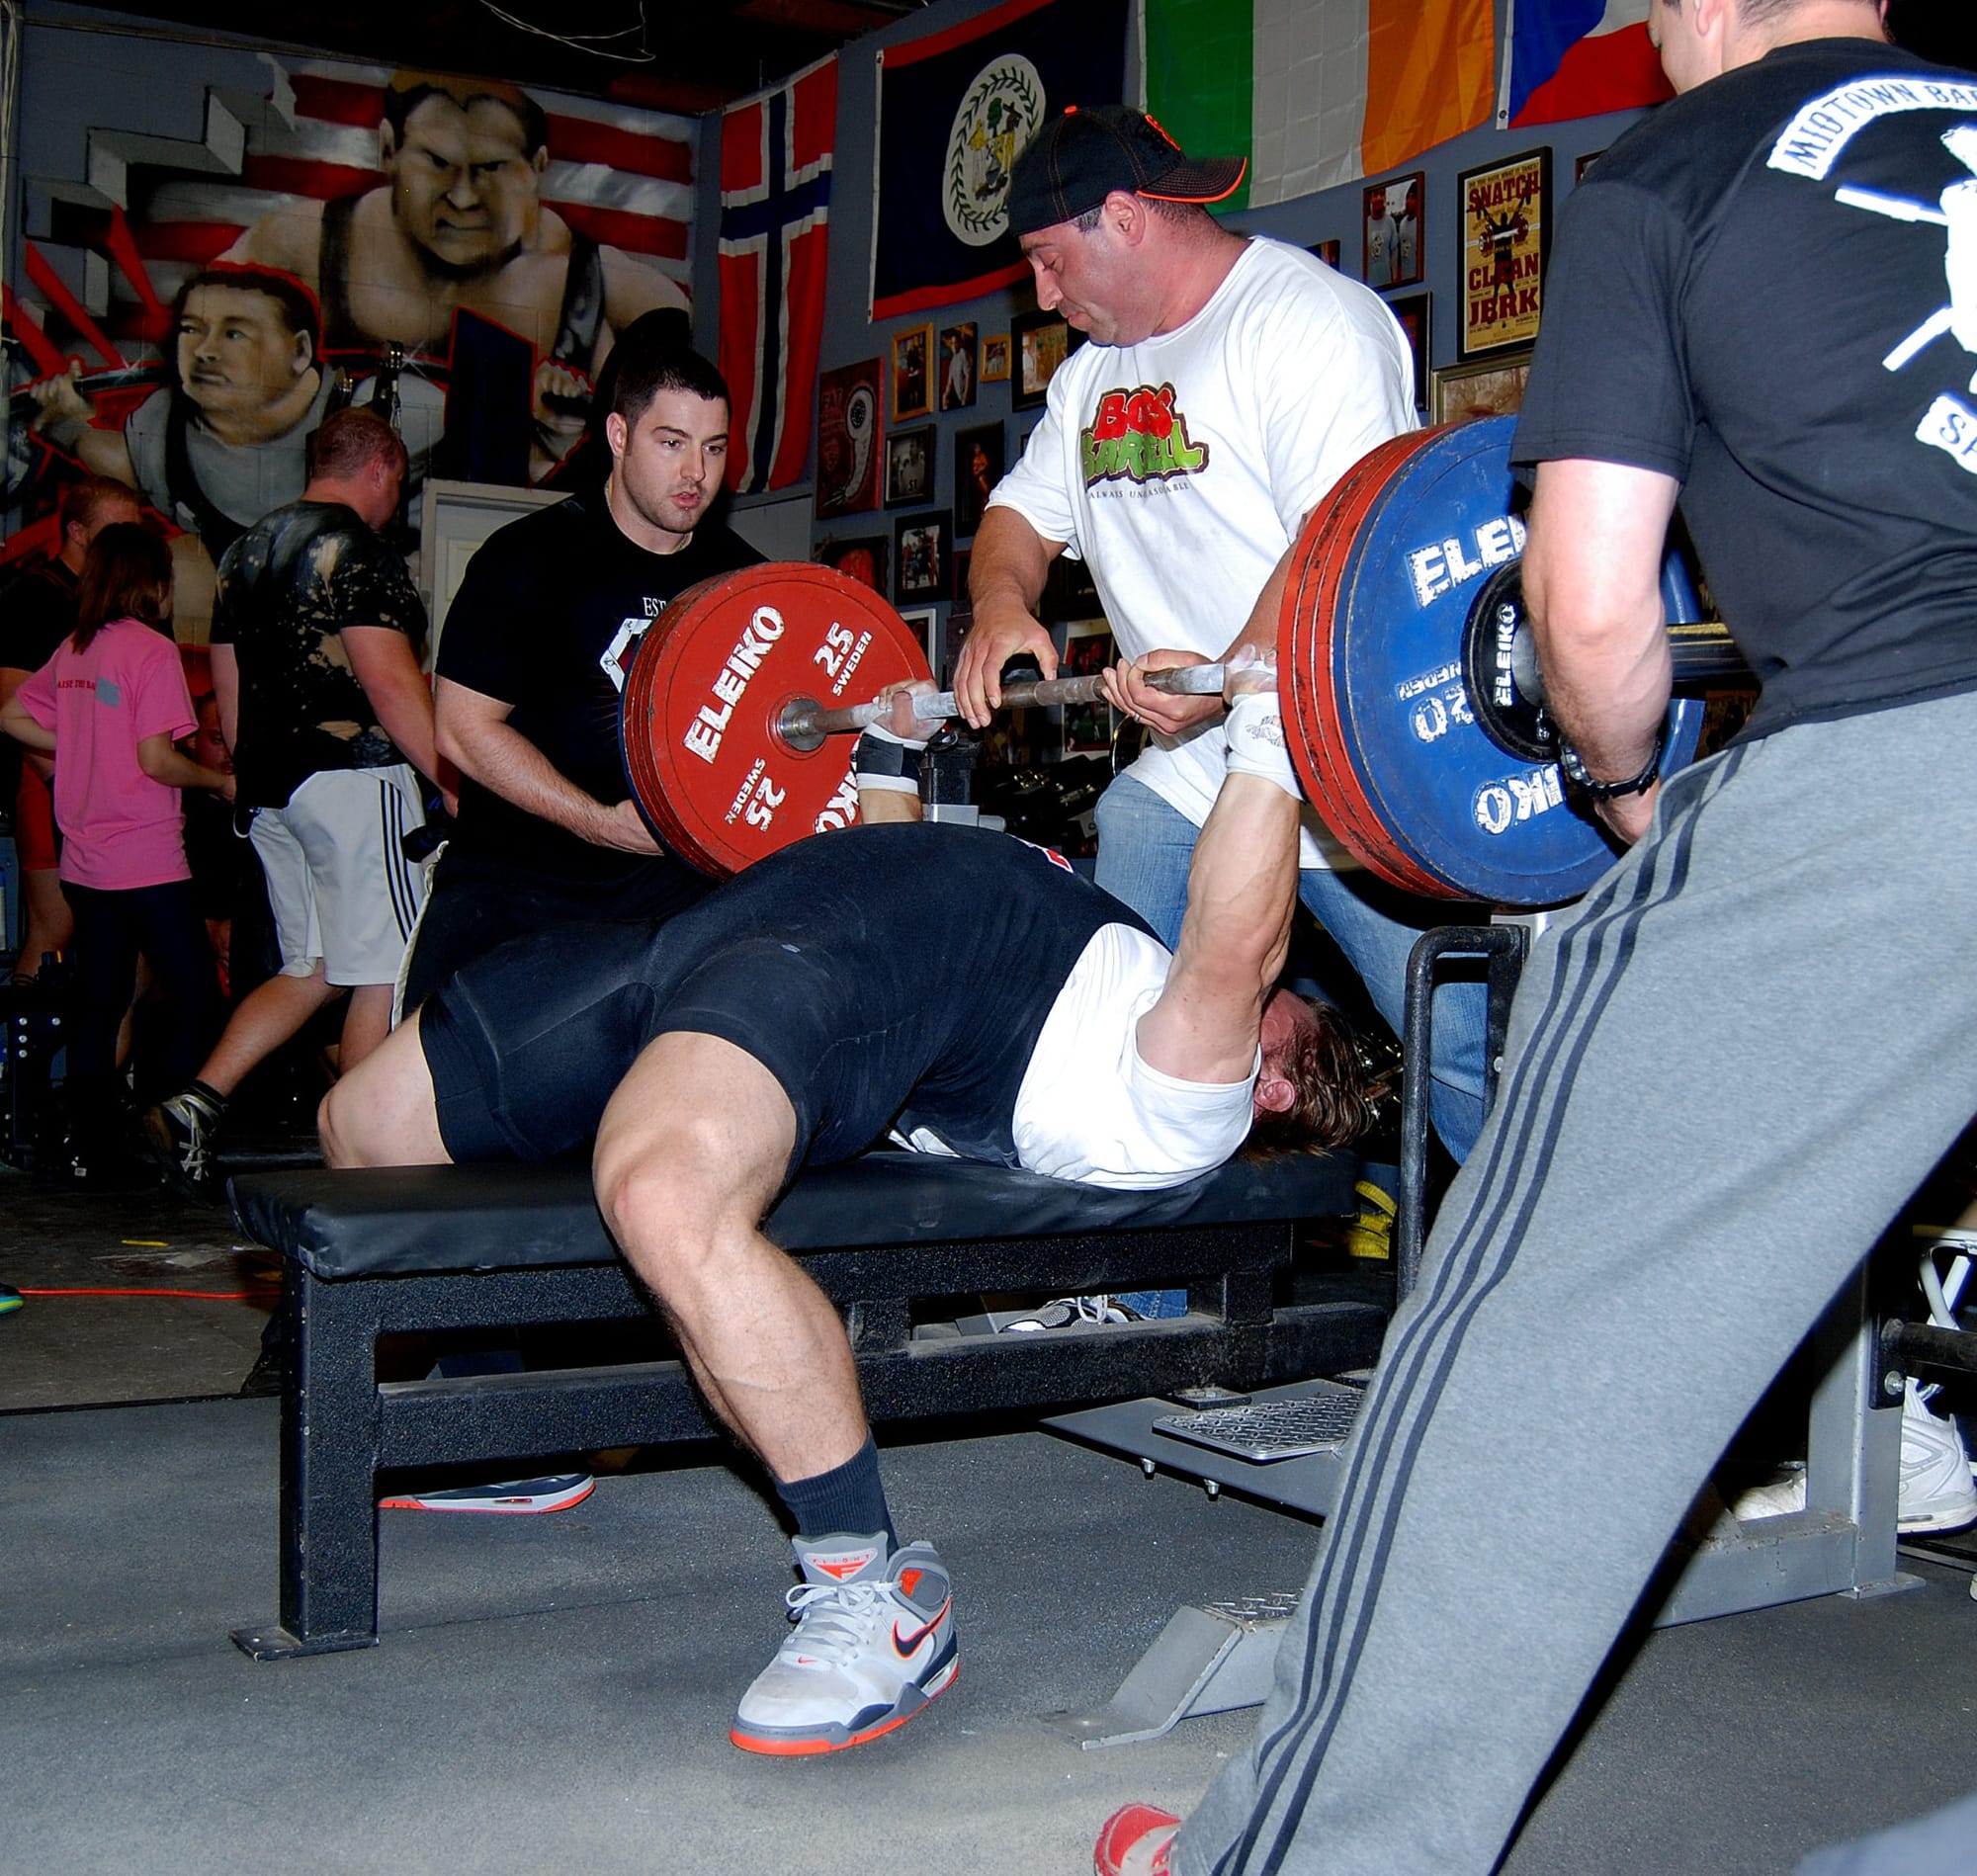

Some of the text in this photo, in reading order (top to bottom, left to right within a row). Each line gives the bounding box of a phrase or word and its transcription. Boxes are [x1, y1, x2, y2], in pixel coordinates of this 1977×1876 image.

[1783, 83, 1921, 169] MIDTOWN
[1468, 170, 1539, 213] SNATCH
[1468, 287, 1539, 327] JERK
[813, 621, 854, 678] 25
[831, 631, 874, 697] SWEDEN
[1493, 601, 1516, 707] ELEIKO
[681, 604, 786, 765] ELEIKO
[724, 757, 767, 825] SWEDEN
[743, 776, 787, 833] 25
